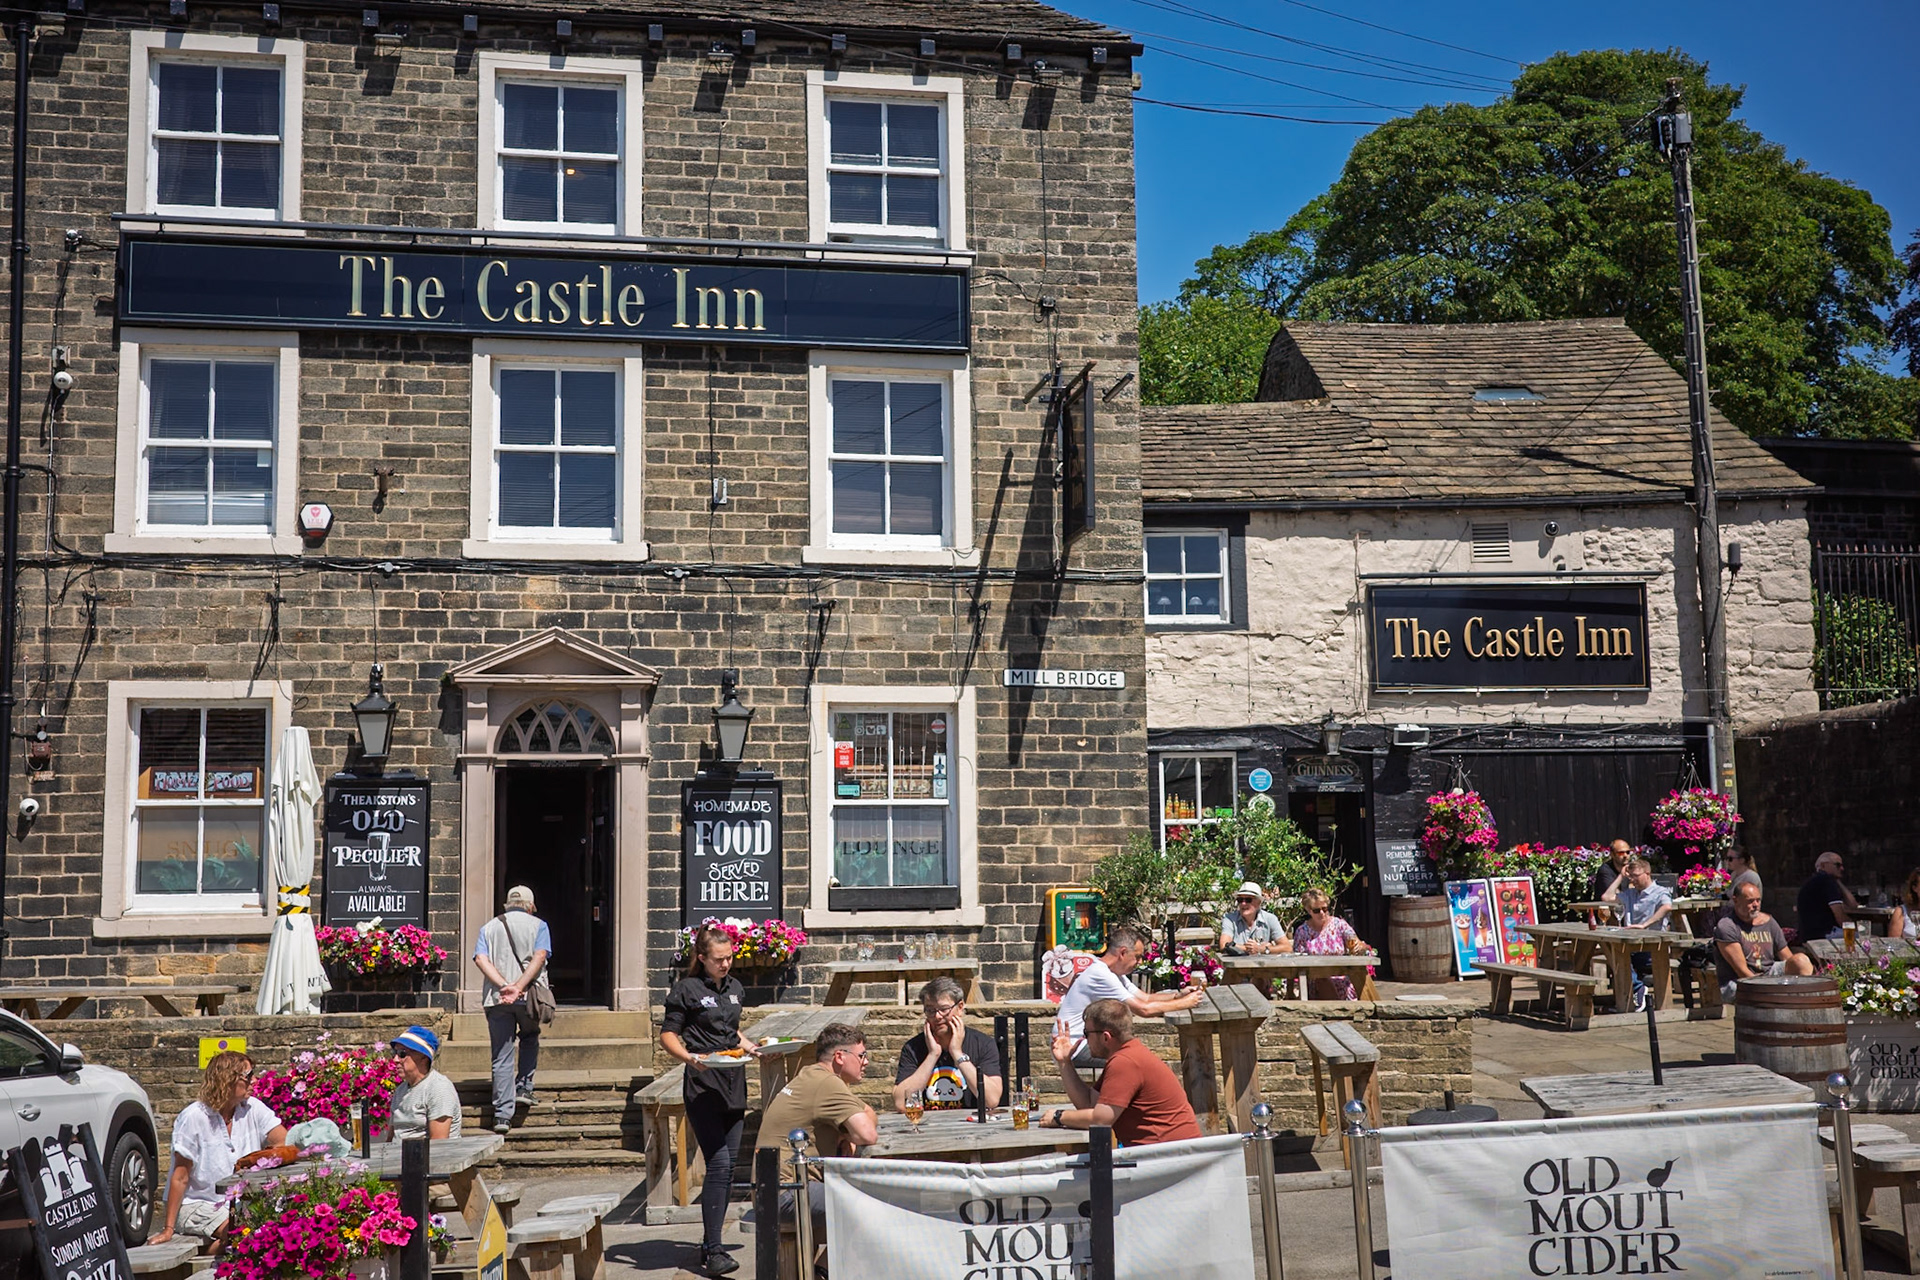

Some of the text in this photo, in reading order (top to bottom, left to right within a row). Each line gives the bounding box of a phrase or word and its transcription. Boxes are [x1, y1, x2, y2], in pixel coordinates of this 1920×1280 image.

[339, 255, 767, 331] The Castle Inn
[1385, 616, 1634, 659] The Castle Inn
[1011, 671, 1118, 686] MILL BRIDGE
[1297, 763, 1354, 777] GUINNESS
[213, 773, 251, 789] FOOD
[341, 793, 416, 806] THEAKSTON'S
[693, 799, 772, 814] HOMEMADE
[352, 809, 405, 832] OLD
[693, 819, 772, 856] FOOD
[166, 840, 238, 858] SNUG
[843, 839, 940, 855] LOUNGE
[1385, 850, 1427, 859] REMEMBED
[332, 845, 422, 867] PECULIER
[708, 859, 760, 881] SERVED
[1383, 872, 1434, 881] NUMBER?
[700, 881, 769, 901] HERE!
[347, 895, 406, 912] AVAILABLE!
[1868, 1043, 1901, 1055] OLD
[1870, 1067, 1920, 1079] CIDER
[1523, 1156, 1620, 1196] OLD
[62, 1187, 73, 1199] THE
[45, 1192, 98, 1226] CASTLE INN
[959, 1195, 1052, 1225] OLD
[1523, 1190, 1684, 1235] MOUT
[65, 1215, 84, 1228] SKIPTON
[50, 1226, 110, 1267] SUNDAY NIGHT
[1528, 1233, 1688, 1277] CIDER
[83, 1259, 92, 1270] IS
